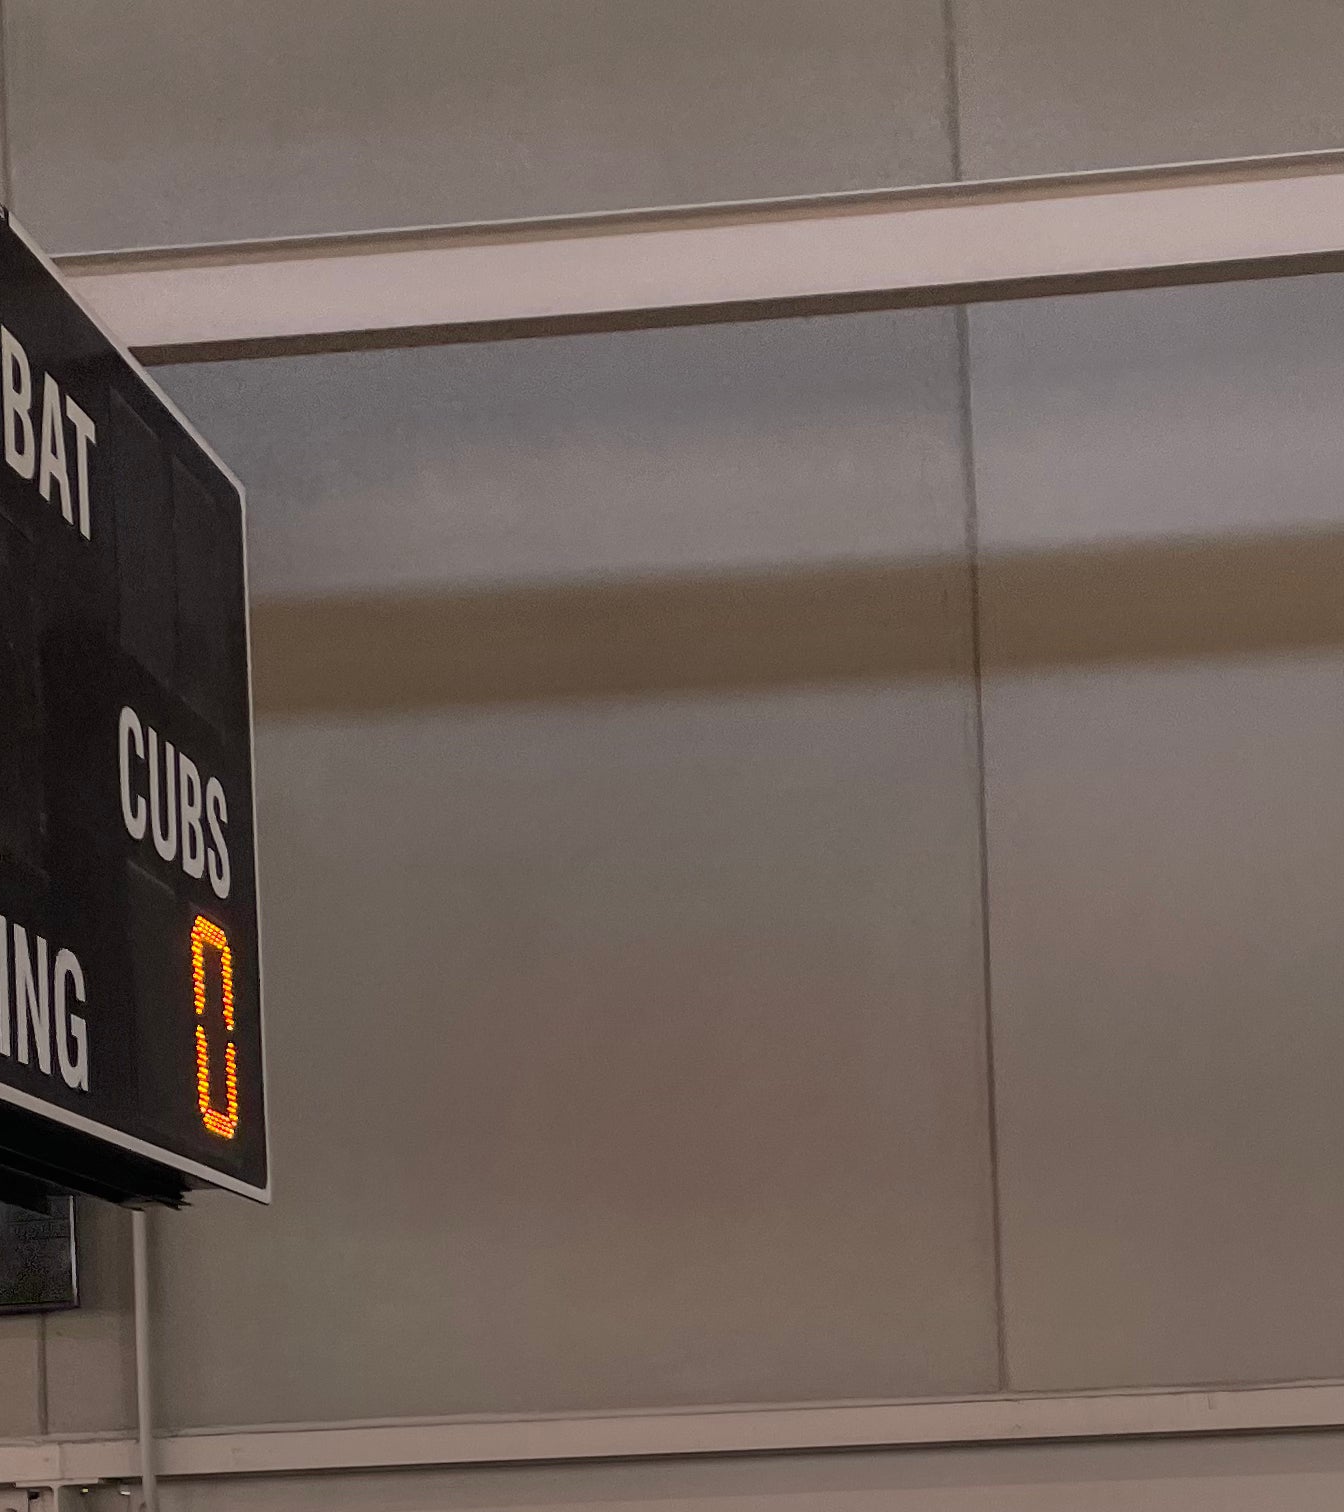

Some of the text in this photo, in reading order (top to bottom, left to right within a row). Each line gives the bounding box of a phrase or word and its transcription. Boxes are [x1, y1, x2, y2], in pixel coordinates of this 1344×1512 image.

[1, 326, 96, 541] BAT
[118, 706, 231, 898] CUBS
[191, 914, 238, 1140] 0
